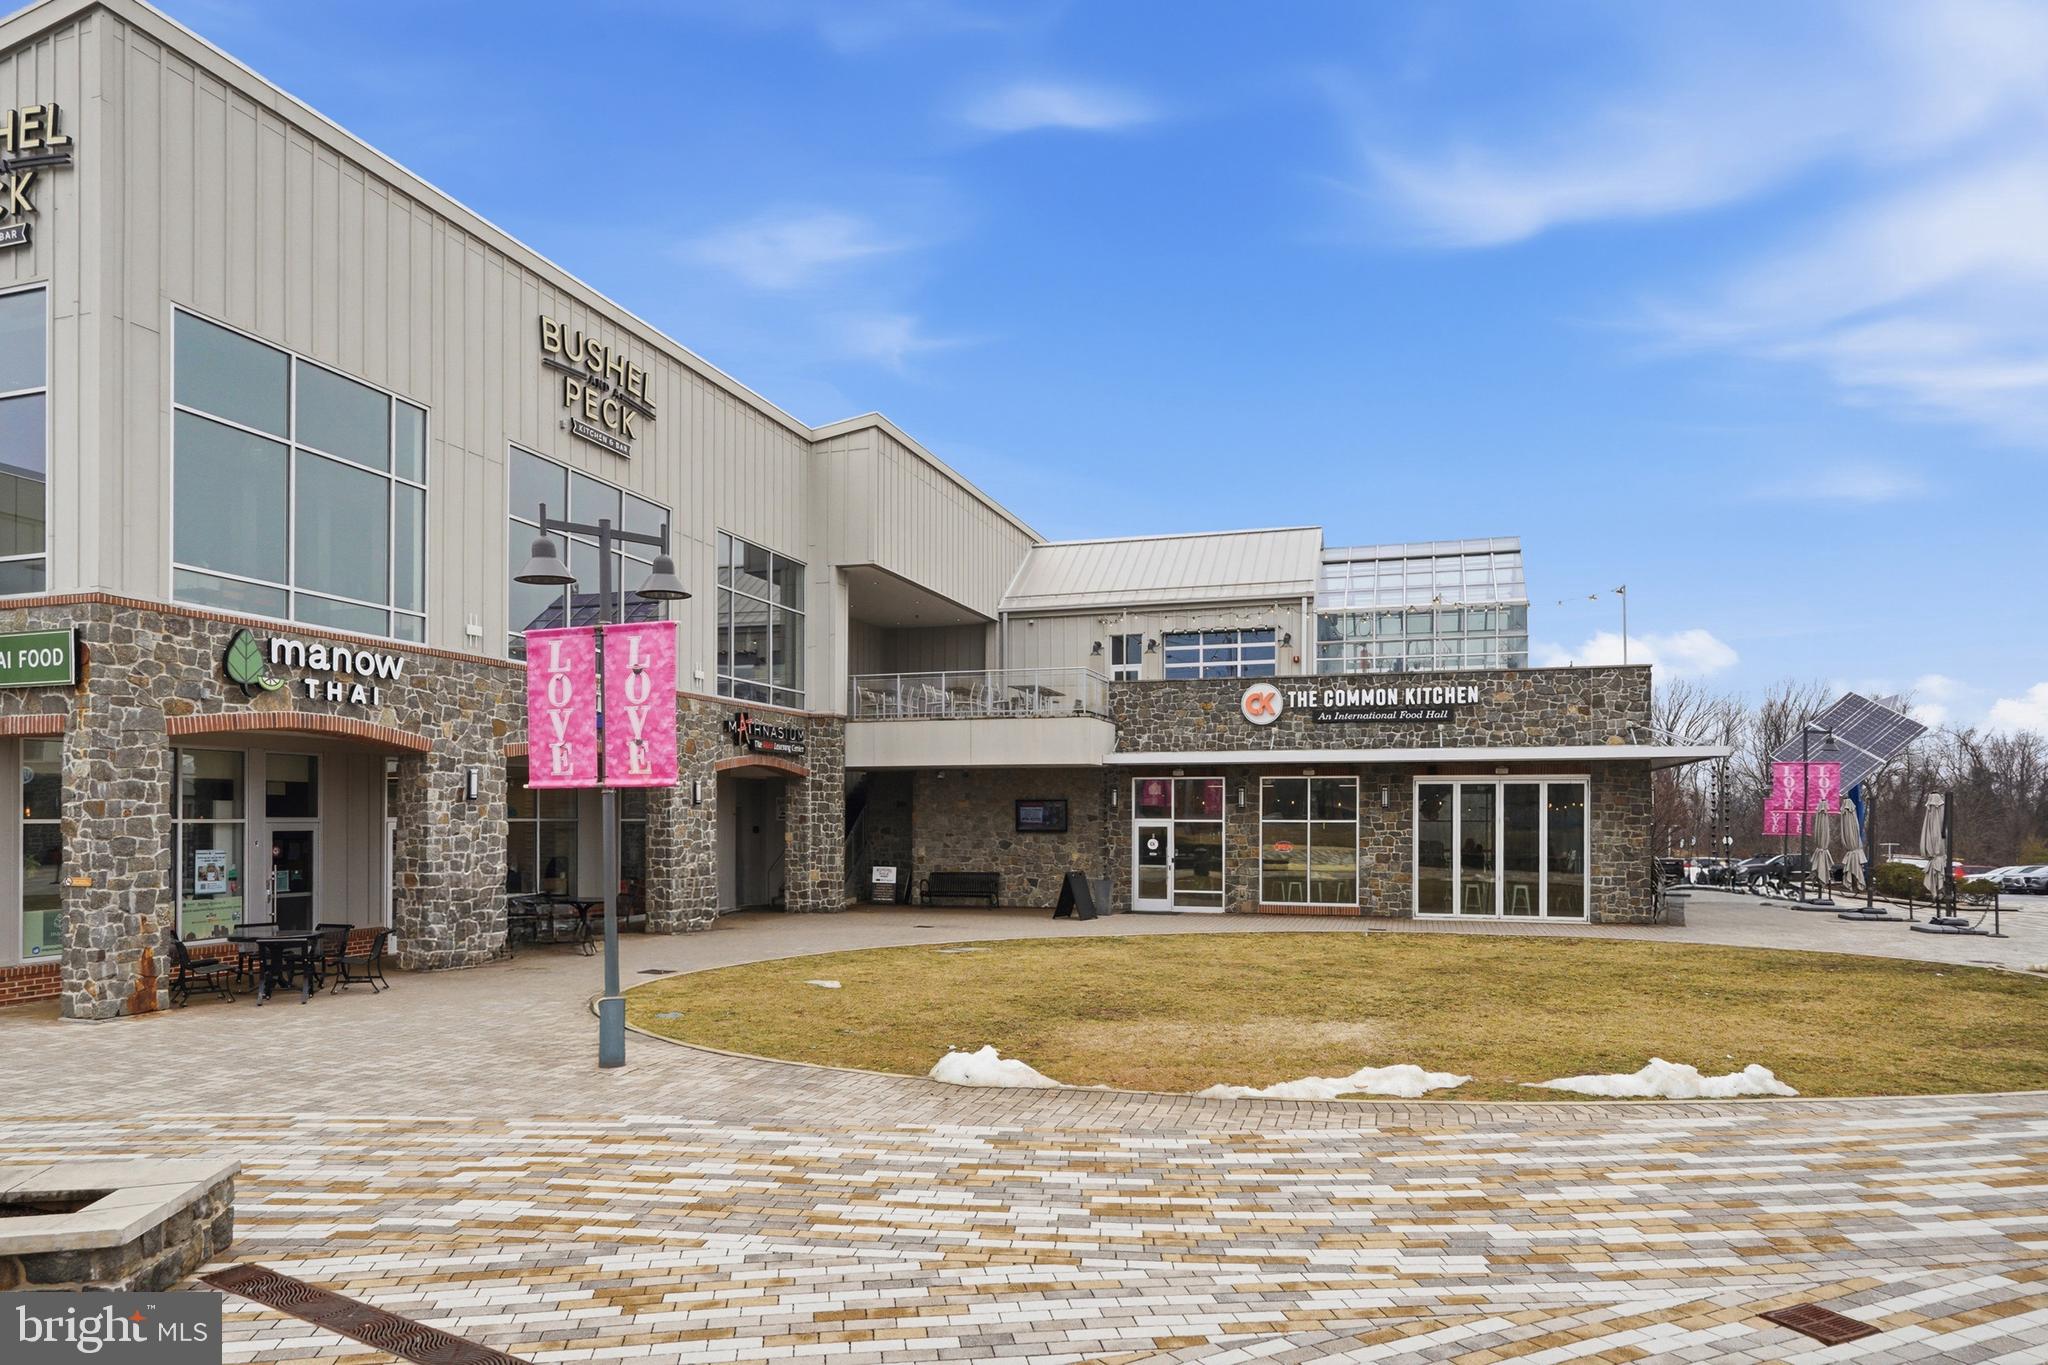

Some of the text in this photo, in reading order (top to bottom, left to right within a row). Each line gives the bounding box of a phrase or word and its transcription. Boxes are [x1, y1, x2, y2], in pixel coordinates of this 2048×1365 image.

[0, 231, 17, 241] BAR
[540, 315, 656, 409] BUSHEL
[564, 375, 637, 440] PECK
[578, 423, 608, 444] KITCHEN
[615, 440, 628, 453] BAR
[18, 647, 64, 668] FOOD
[269, 636, 404, 680] manow
[304, 678, 380, 706] THAI
[546, 640, 575, 776] LOVE
[624, 635, 653, 775] LOVE
[1288, 686, 1479, 708] THE COMMON KITCHEN
[727, 711, 804, 744] MATHNASIUM
[1318, 710, 1448, 721] An International Food Hall
[774, 742, 791, 753] Learning
[791, 744, 804, 752] Center
[1782, 766, 1796, 810] LOVE
[1817, 765, 1830, 802] LOV
